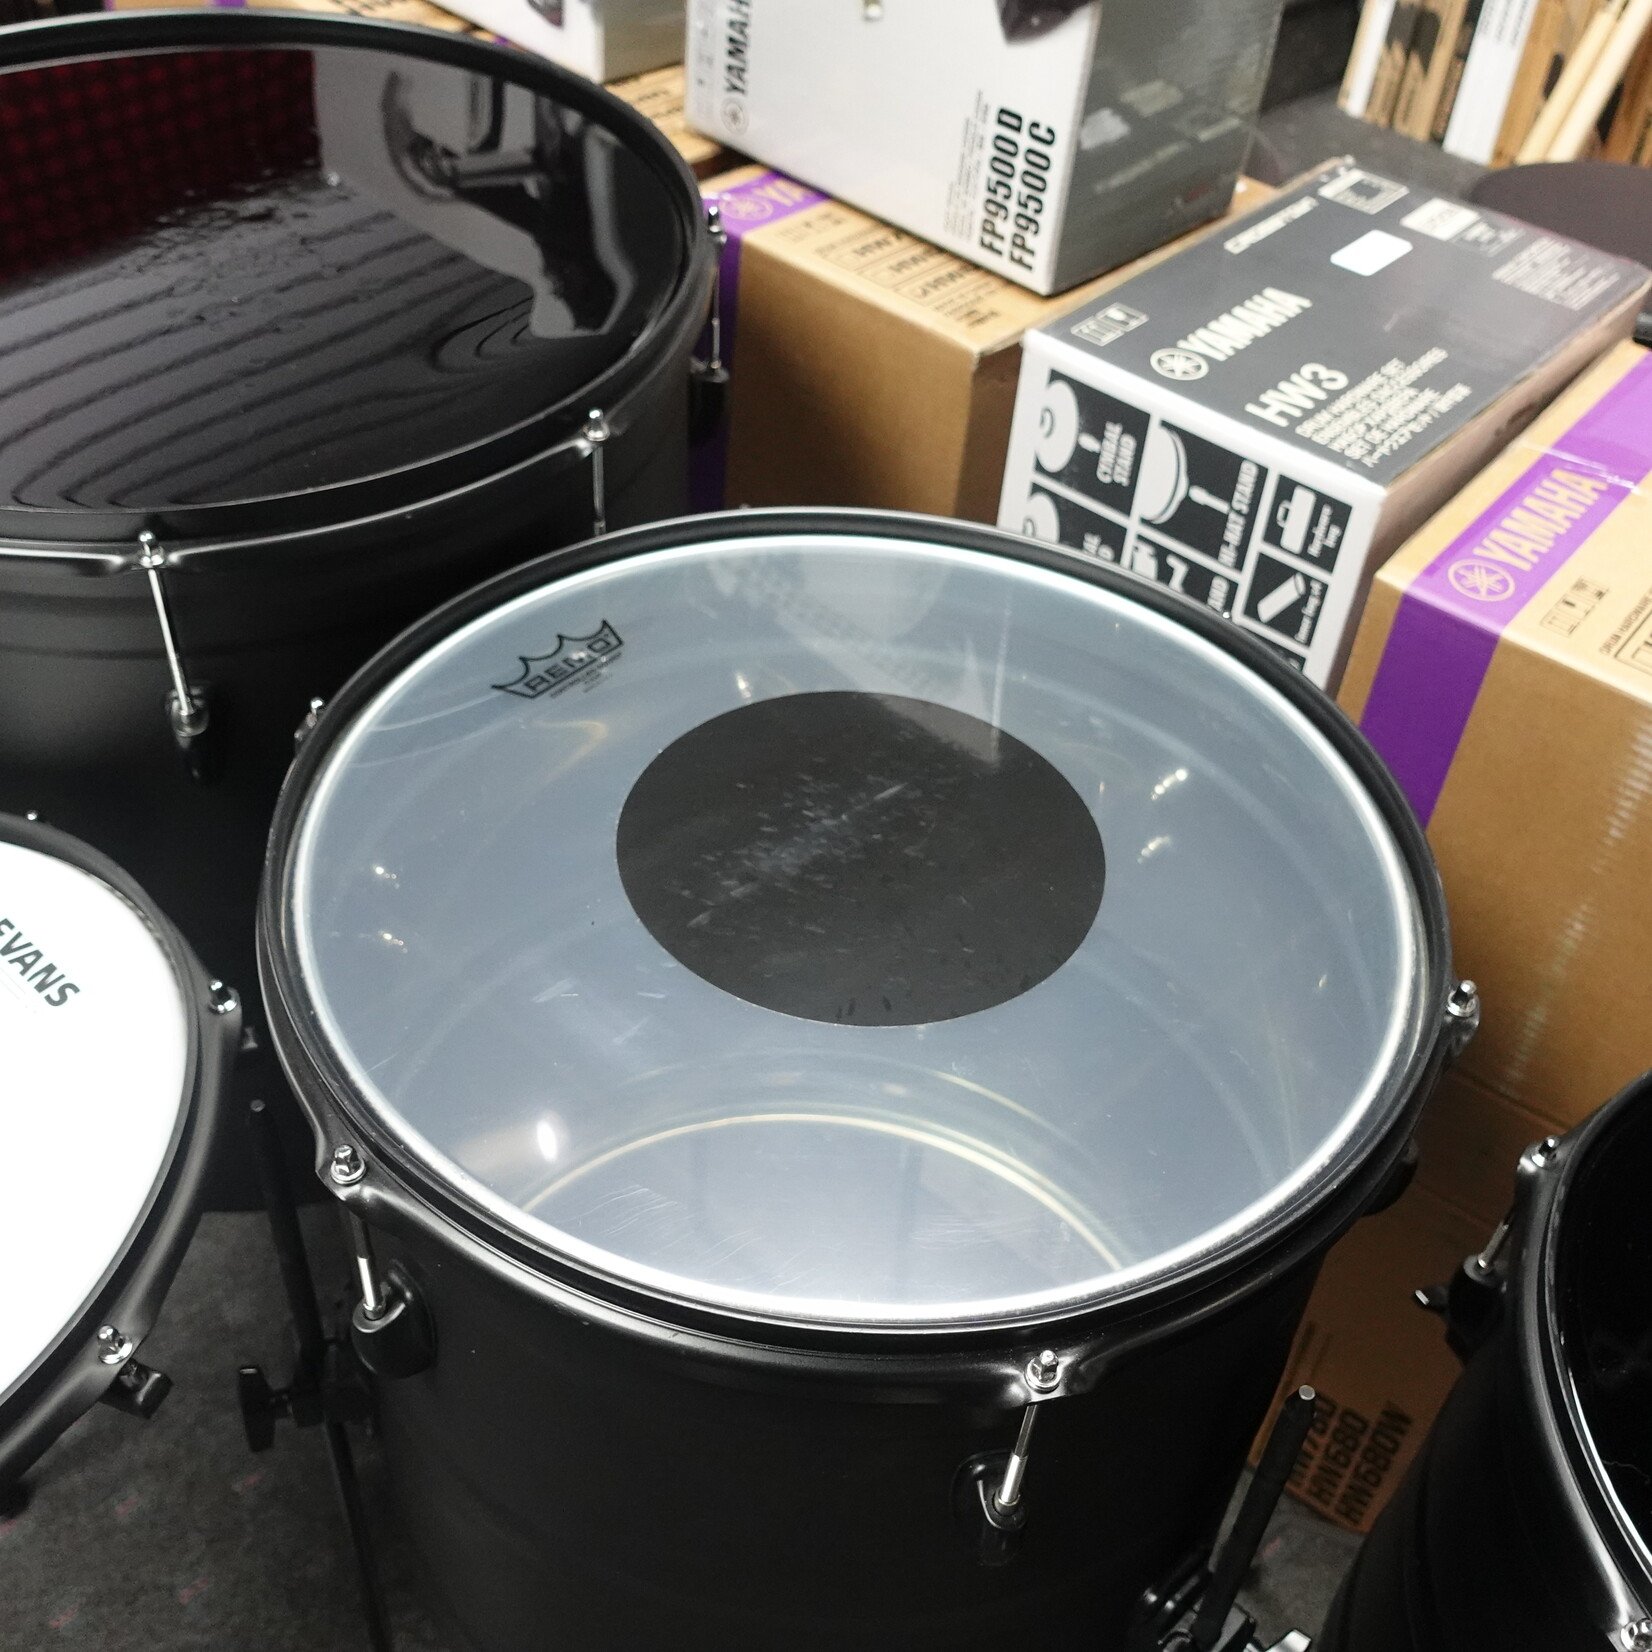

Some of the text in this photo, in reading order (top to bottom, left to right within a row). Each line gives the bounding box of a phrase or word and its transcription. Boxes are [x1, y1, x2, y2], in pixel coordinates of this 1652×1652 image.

[1176, 286, 1314, 362] YAMAHA
[1244, 362, 1349, 428] HW3
[1096, 420, 1123, 484] CYMBAL
[1112, 433, 1137, 487] STAND
[1217, 459, 1260, 568] HI-HAT STAND
[1472, 467, 1609, 572] YAMAHA
